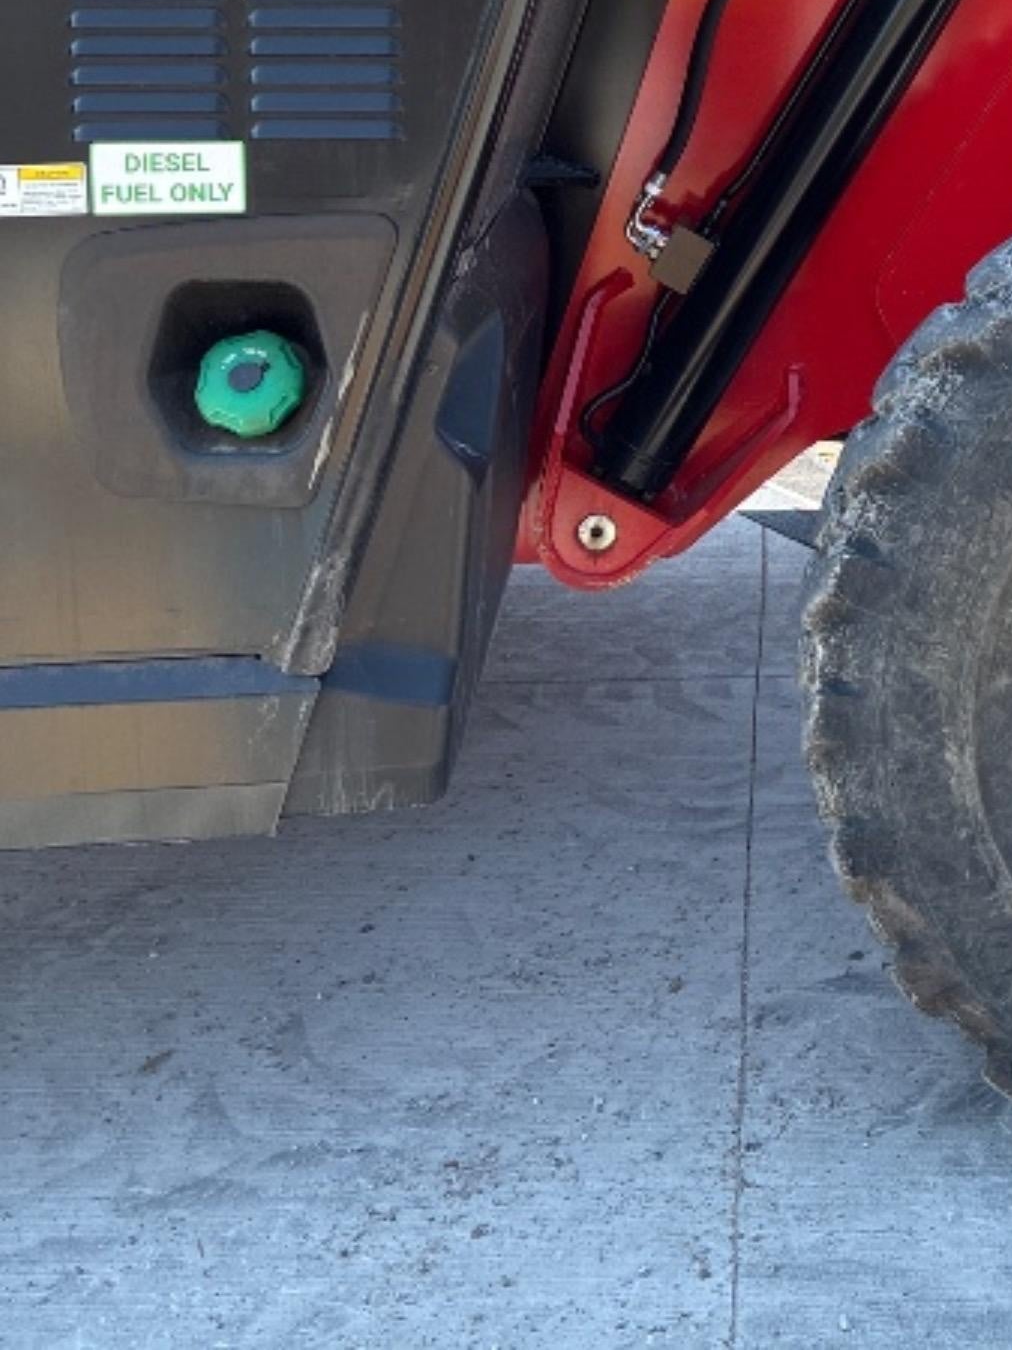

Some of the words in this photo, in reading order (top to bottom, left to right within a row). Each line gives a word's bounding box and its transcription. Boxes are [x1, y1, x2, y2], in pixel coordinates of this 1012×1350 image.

[125, 152, 211, 173] DIESEL
[100, 183, 163, 204] FUEL
[170, 181, 235, 202] ONLY
